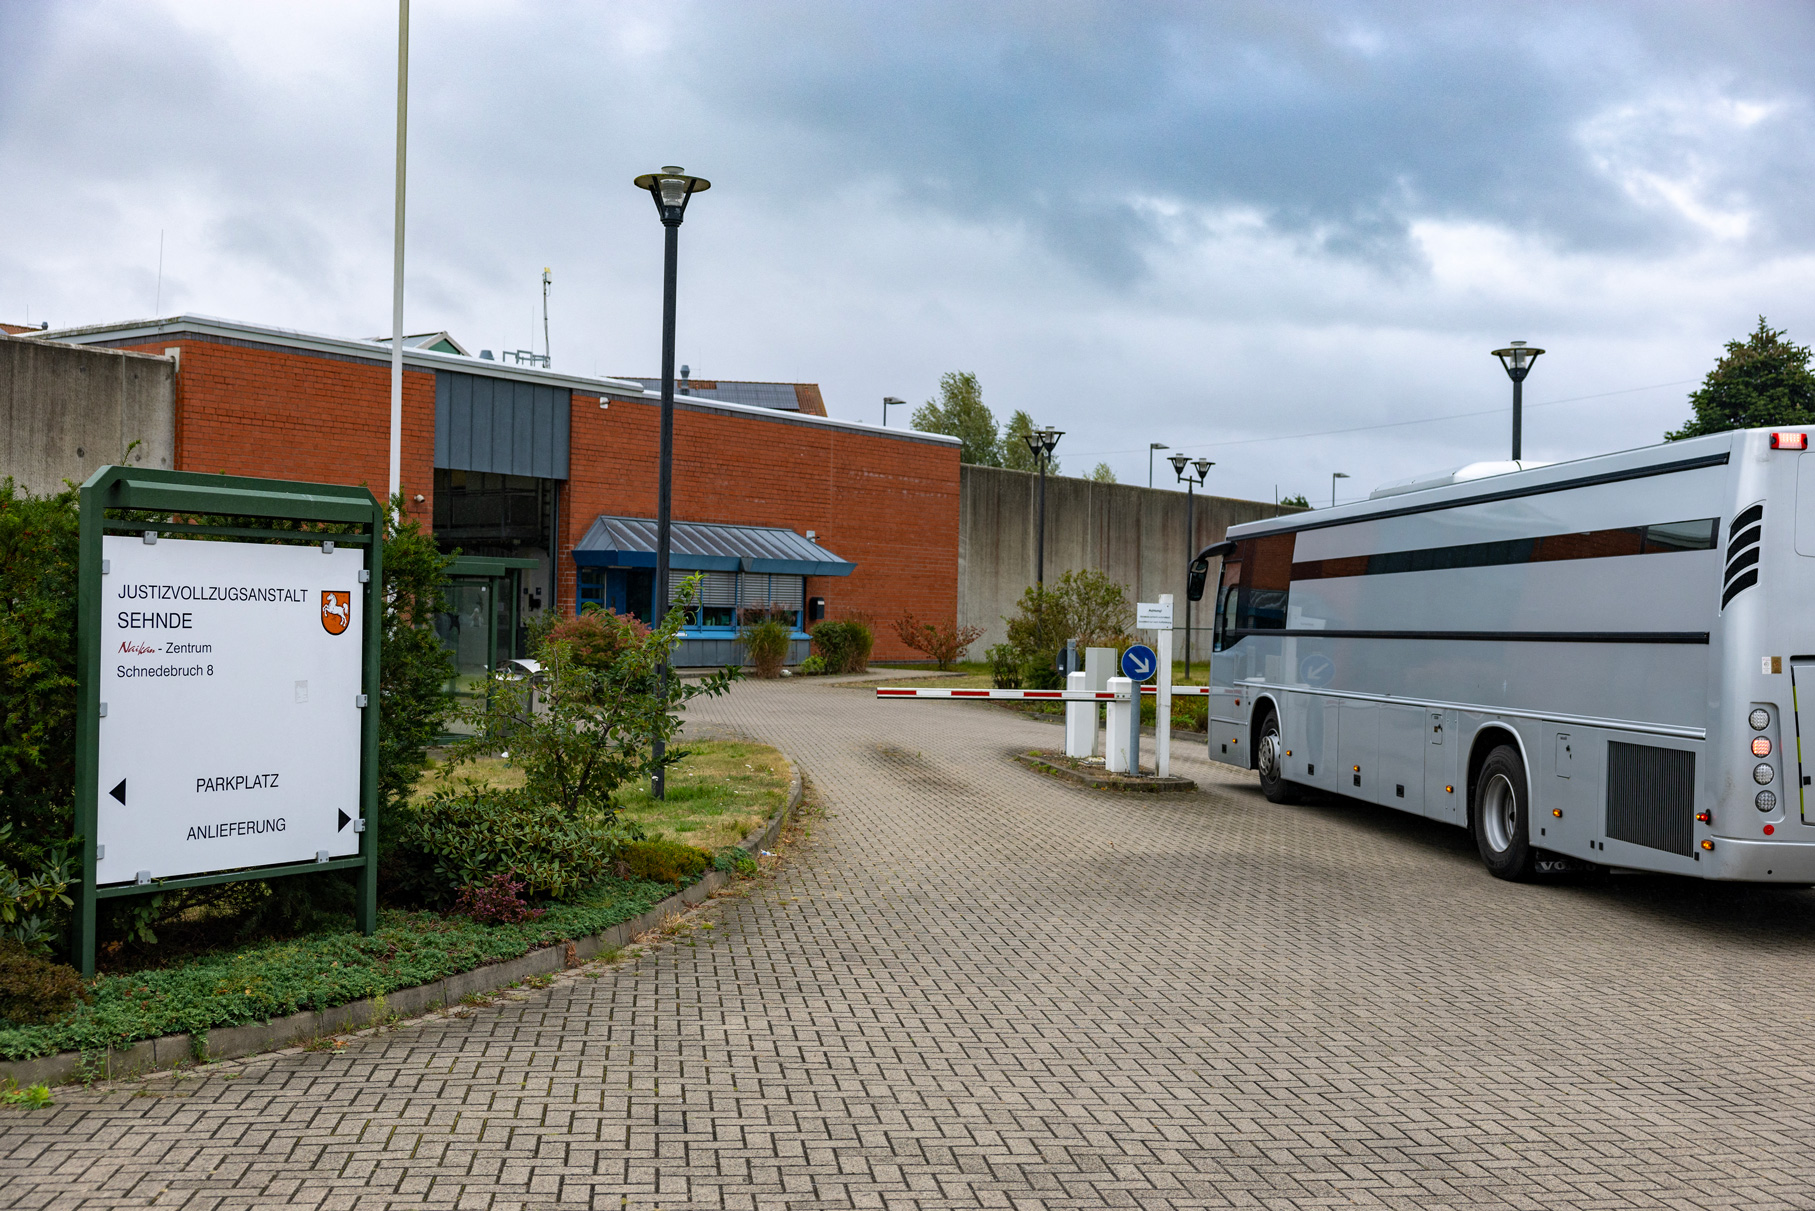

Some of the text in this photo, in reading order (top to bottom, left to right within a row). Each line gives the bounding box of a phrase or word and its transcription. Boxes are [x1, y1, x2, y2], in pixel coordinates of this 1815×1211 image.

[118, 584, 308, 602] JUSTIZVOLLZUGSANSTALT
[117, 611, 193, 629] SEHNDE
[165, 642, 212, 654] Zentrum
[116, 664, 214, 678] Schnedebruch 8
[196, 774, 279, 793] PARKPLATZ
[186, 818, 285, 840] ANLIEFERUNG
